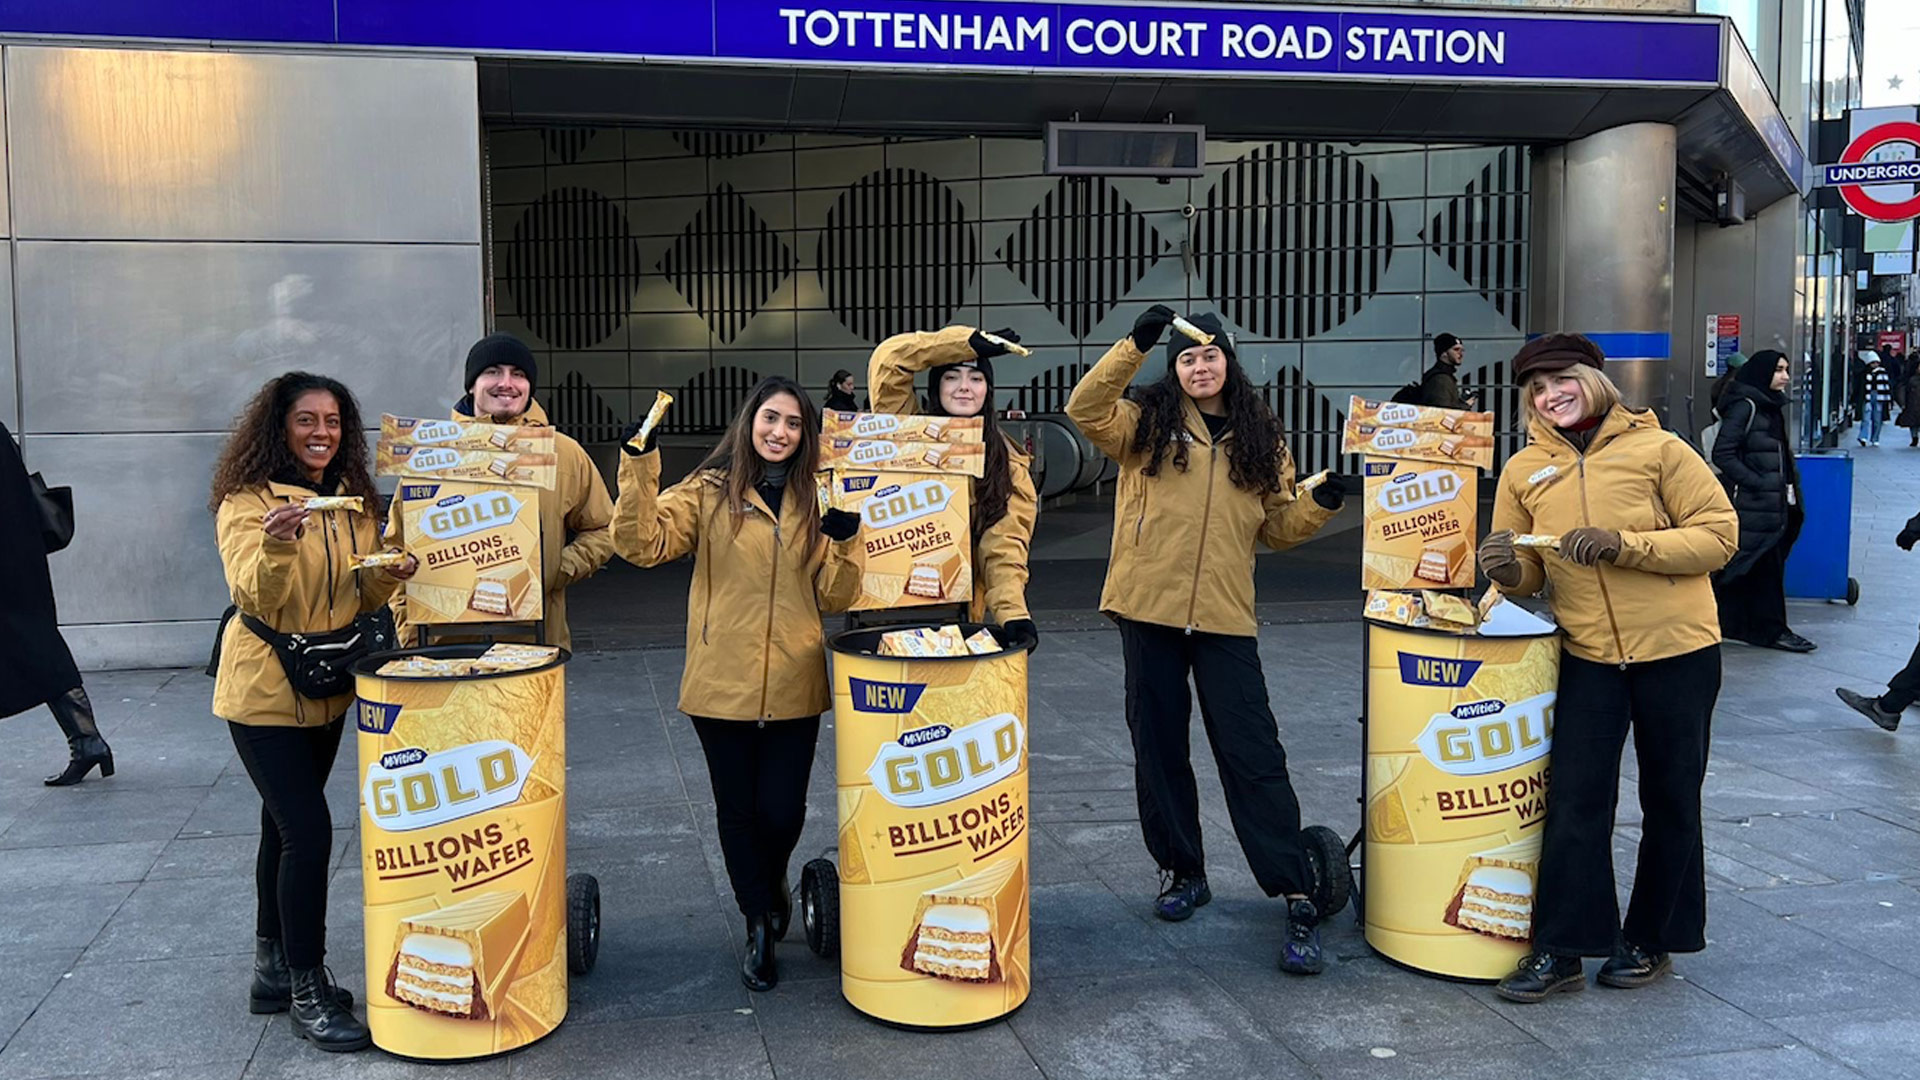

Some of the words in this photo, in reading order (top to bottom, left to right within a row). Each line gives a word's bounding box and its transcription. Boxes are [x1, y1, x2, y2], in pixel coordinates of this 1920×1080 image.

[779, 8, 1050, 52] TOTTENHAM
[1065, 18, 1207, 57] COURT
[1222, 23, 1332, 60] ROAD
[1346, 26, 1505, 64] STATION
[1830, 164, 1920, 181] UNDERGRO
[857, 419, 895, 433] GOLD
[1381, 408, 1415, 421] GOLD
[418, 426, 459, 440] GOLD
[1377, 433, 1412, 447] GOLD
[414, 453, 456, 468] GOLD
[854, 445, 893, 460] GOLD
[1370, 464, 1391, 475] NEW
[409, 486, 432, 498] NEW
[849, 477, 870, 491] NEW
[1386, 474, 1456, 508] GOLD
[429, 496, 513, 533] GOLD
[867, 485, 945, 523] GOLD
[1382, 509, 1446, 537] BILLIONS
[1420, 519, 1460, 538] WAFER
[865, 522, 936, 553] BILLIONS
[907, 530, 952, 553] WAFER
[426, 535, 502, 565] BILLIONS
[472, 545, 520, 566] WAFER
[1417, 659, 1462, 684] NEW
[865, 684, 906, 709] NEW
[359, 705, 386, 730] NEW
[1456, 700, 1501, 718] McVitie's
[903, 726, 948, 746] McVitie's
[383, 750, 422, 768] McVitie's
[883, 720, 1020, 796] GOLD
[371, 748, 520, 818] GOLD
[888, 793, 1011, 848] BILLIONS
[967, 805, 1025, 853] WAFER
[375, 823, 503, 871] BILLIONS
[445, 837, 532, 882] WAFER
